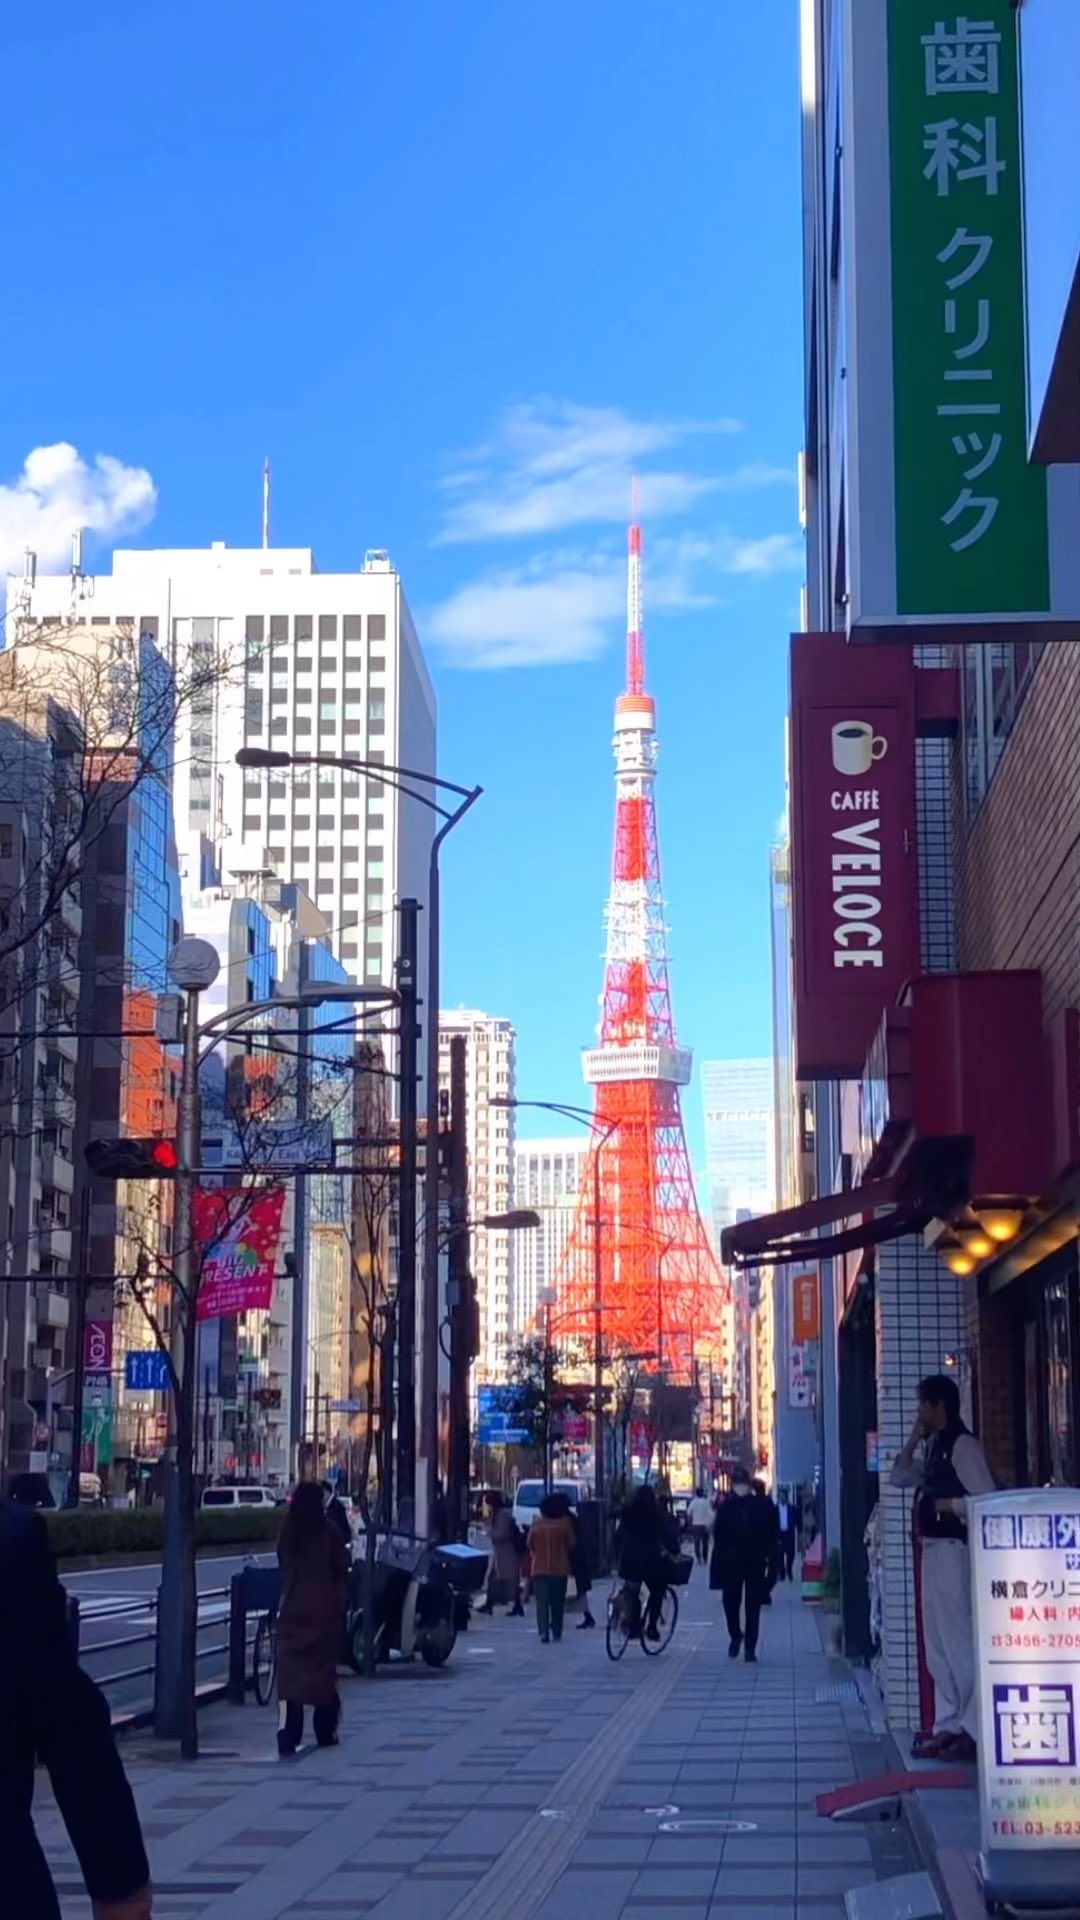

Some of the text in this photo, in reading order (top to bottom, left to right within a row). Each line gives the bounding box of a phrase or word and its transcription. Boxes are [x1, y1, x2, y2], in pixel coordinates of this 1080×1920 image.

[920, 17, 1007, 553] 歯科クリニック
[831, 818, 883, 968] VELOCE
[995, 1685, 1076, 1765] 歯
